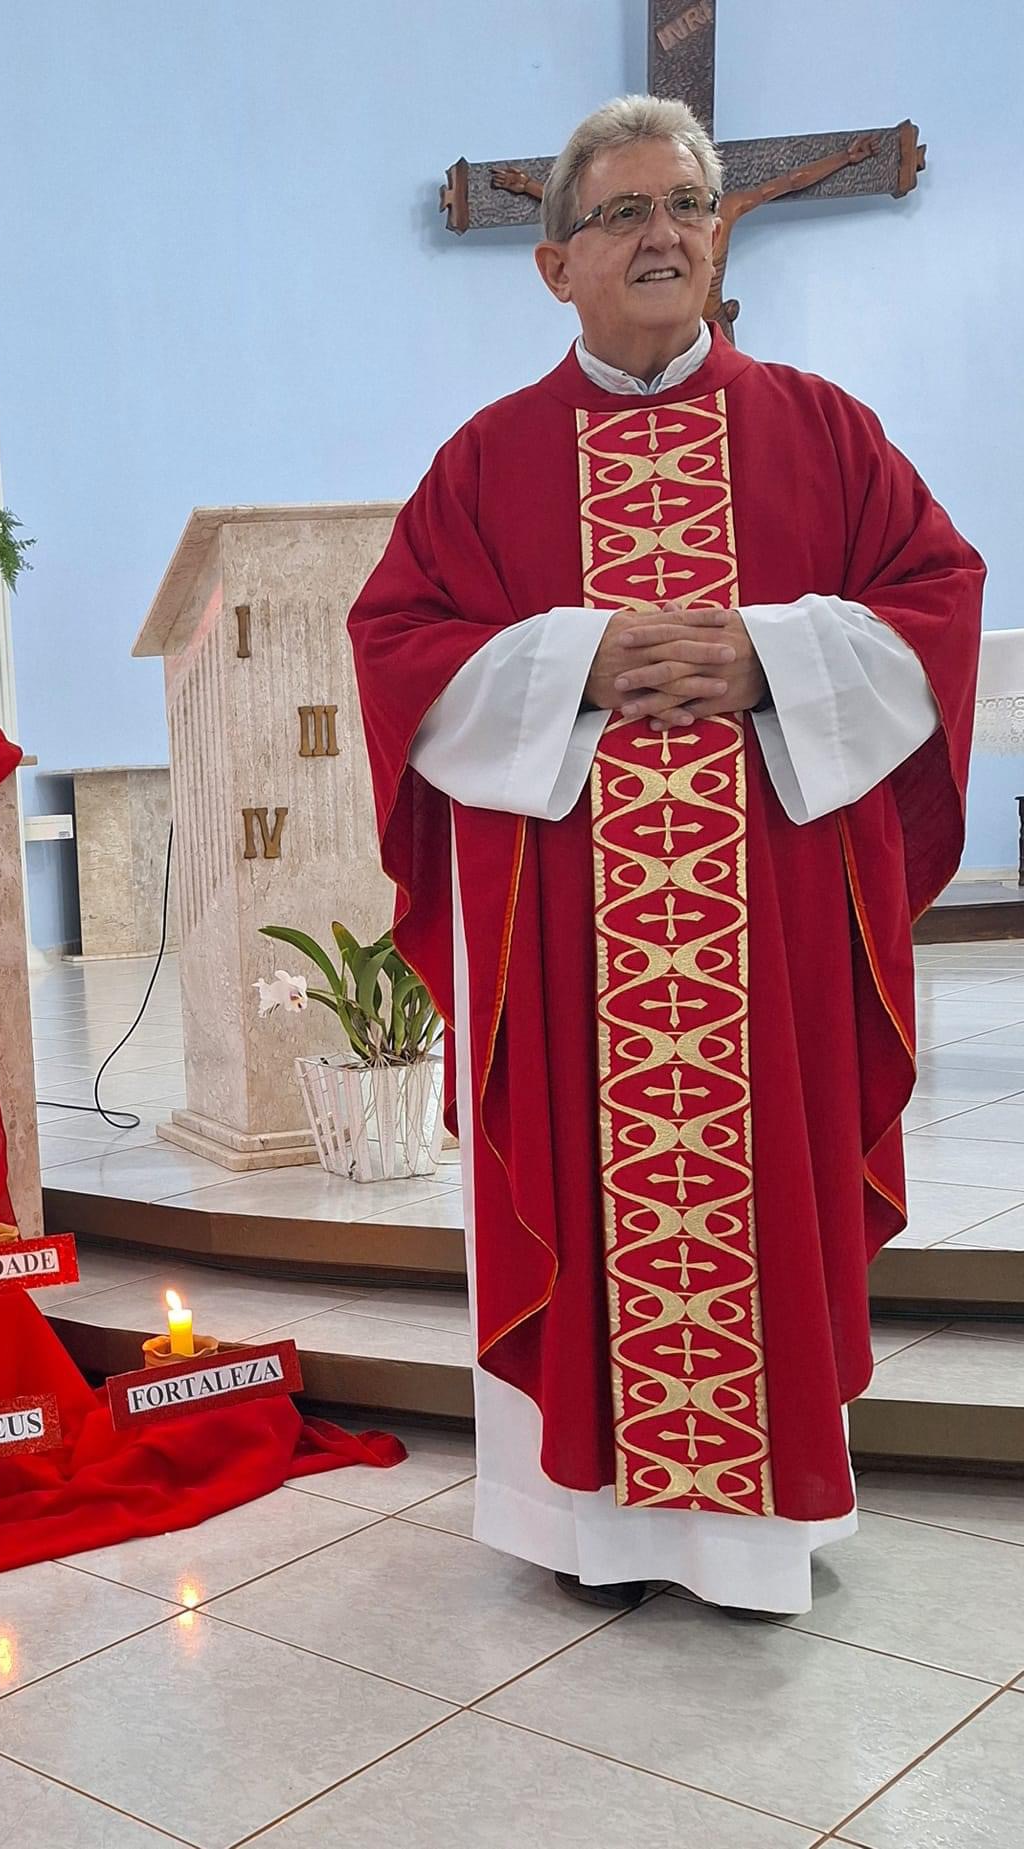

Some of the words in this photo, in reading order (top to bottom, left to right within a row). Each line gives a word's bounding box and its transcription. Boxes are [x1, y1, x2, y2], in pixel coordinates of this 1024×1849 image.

[235, 605, 251, 658] I
[298, 705, 339, 757] III
[242, 807, 288, 859] IV
[129, 1359, 280, 1411] FORTALEZA
